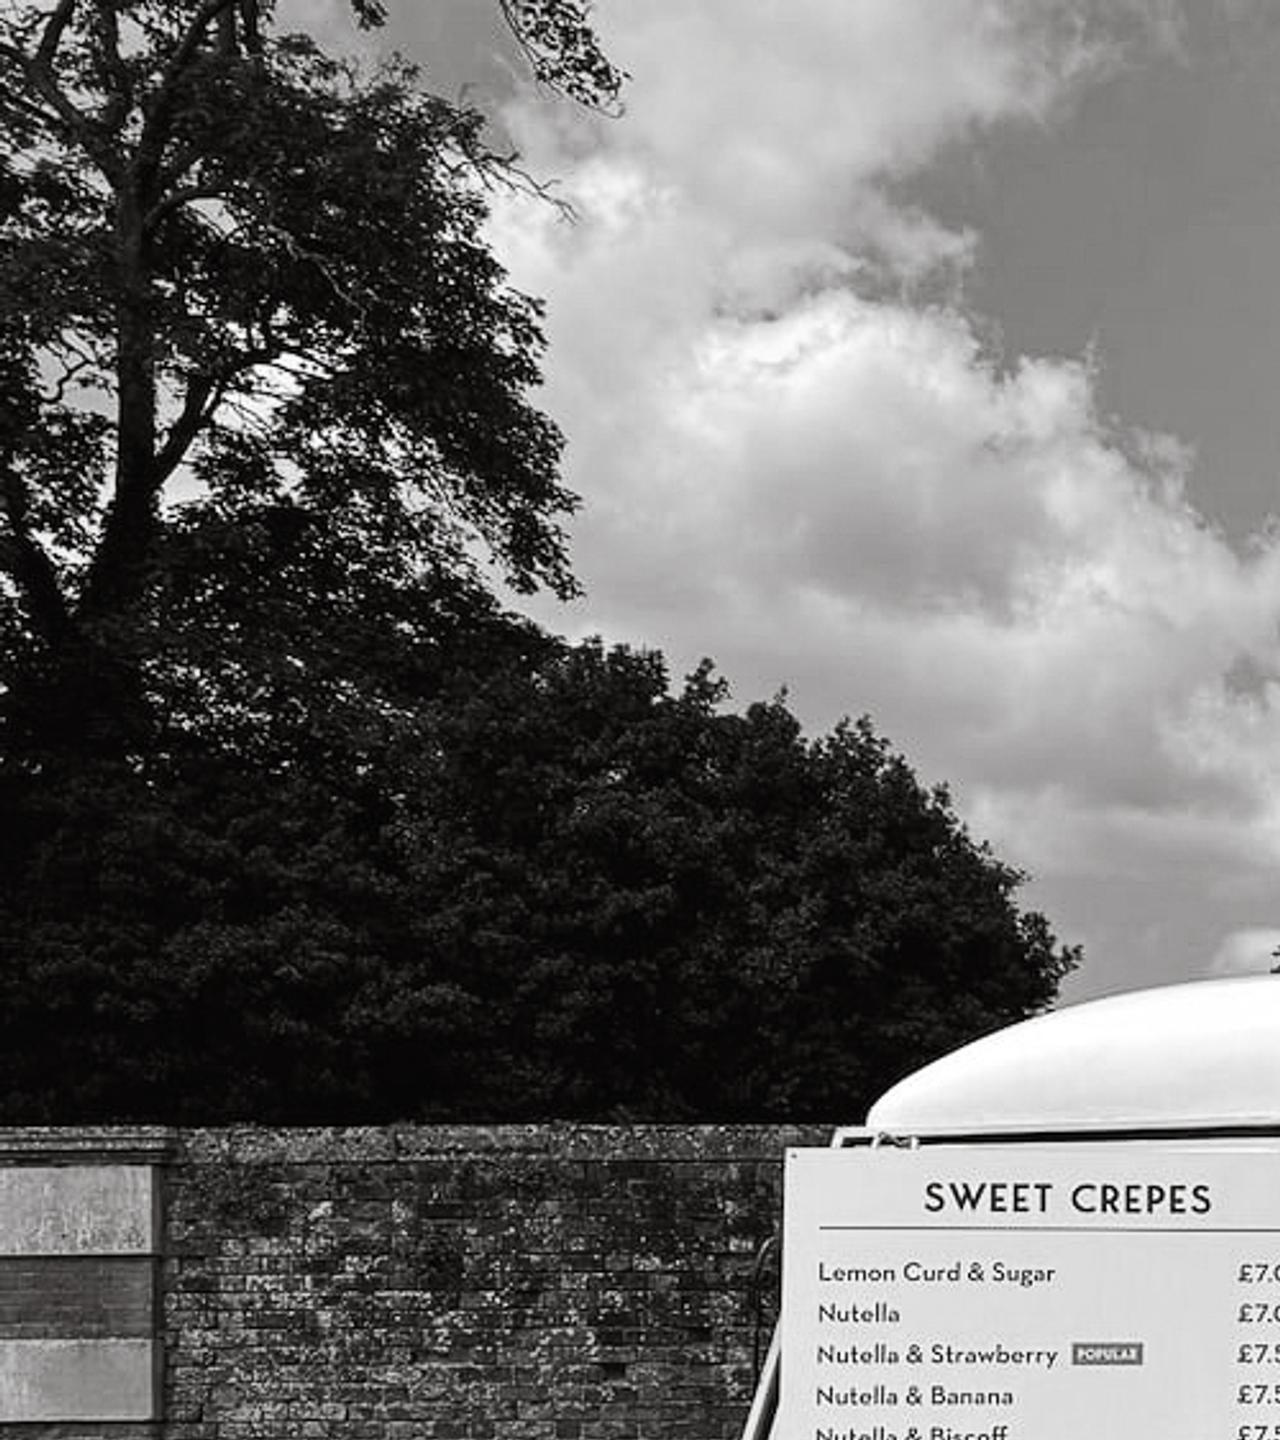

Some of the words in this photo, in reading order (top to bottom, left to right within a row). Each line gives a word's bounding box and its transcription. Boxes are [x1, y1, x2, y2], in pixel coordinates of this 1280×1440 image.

[925, 1183, 1053, 1212] SWEET
[1072, 1184, 1211, 1214] CREPES
[819, 1262, 895, 1281] Lemon
[904, 1262, 961, 1282] Curd
[968, 1262, 984, 1281] &
[993, 1262, 1055, 1288] Sugar
[819, 1302, 900, 1323] Nutella
[817, 1343, 899, 1364] Nutella
[906, 1344, 923, 1364] &
[932, 1344, 1058, 1369] Strawberry
[817, 1385, 897, 1406] Nutella
[906, 1386, 922, 1406] &
[932, 1386, 1013, 1405] Banana
